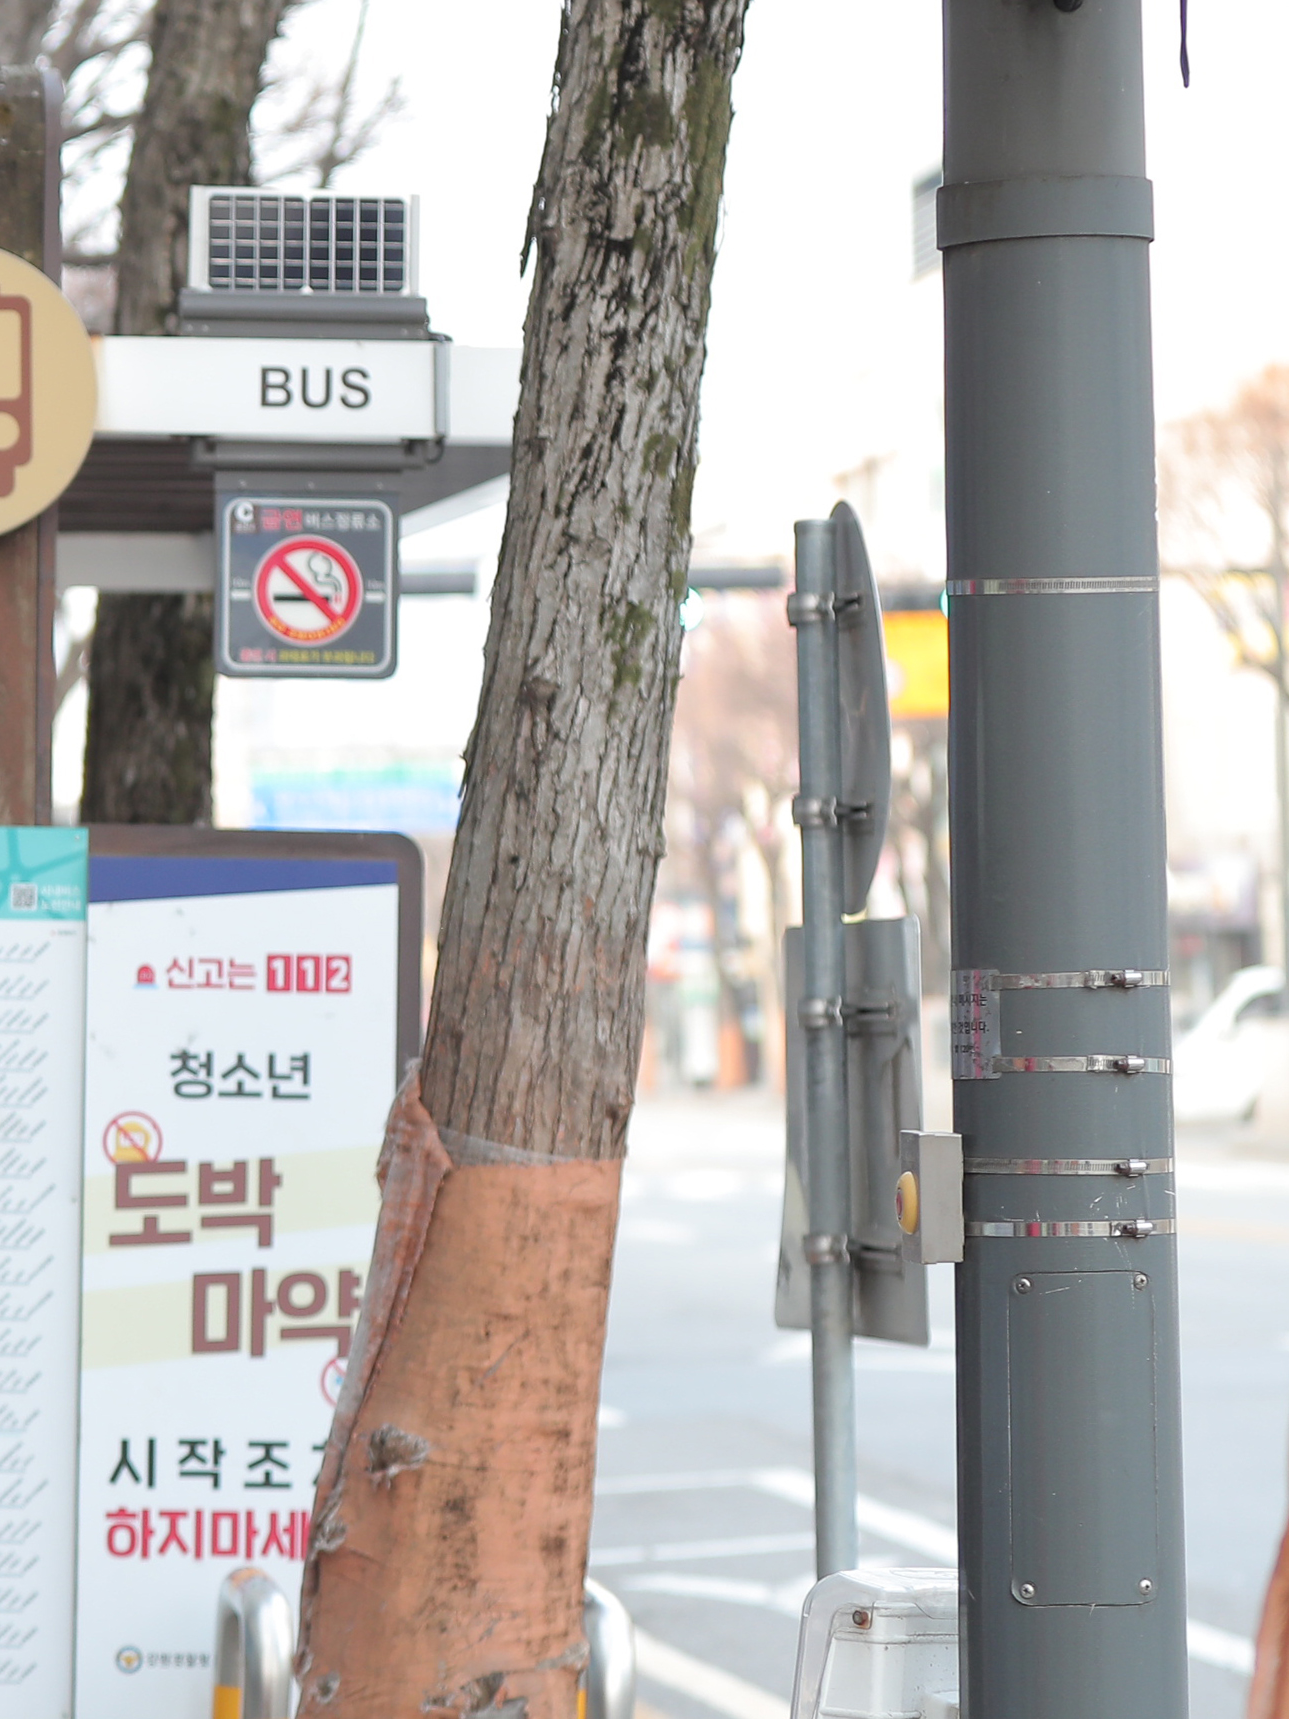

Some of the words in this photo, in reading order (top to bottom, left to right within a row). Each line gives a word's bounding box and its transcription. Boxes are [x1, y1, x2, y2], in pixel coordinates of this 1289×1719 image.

[260, 366, 372, 409] BUS
[261, 509, 303, 531] 금연
[304, 511, 381, 531] 버스정류소
[166, 957, 256, 990] 신고는
[267, 955, 351, 992] 112
[169, 1050, 312, 1100] 청소년
[108, 1157, 284, 1250] 도박
[190, 1267, 362, 1358] 마약
